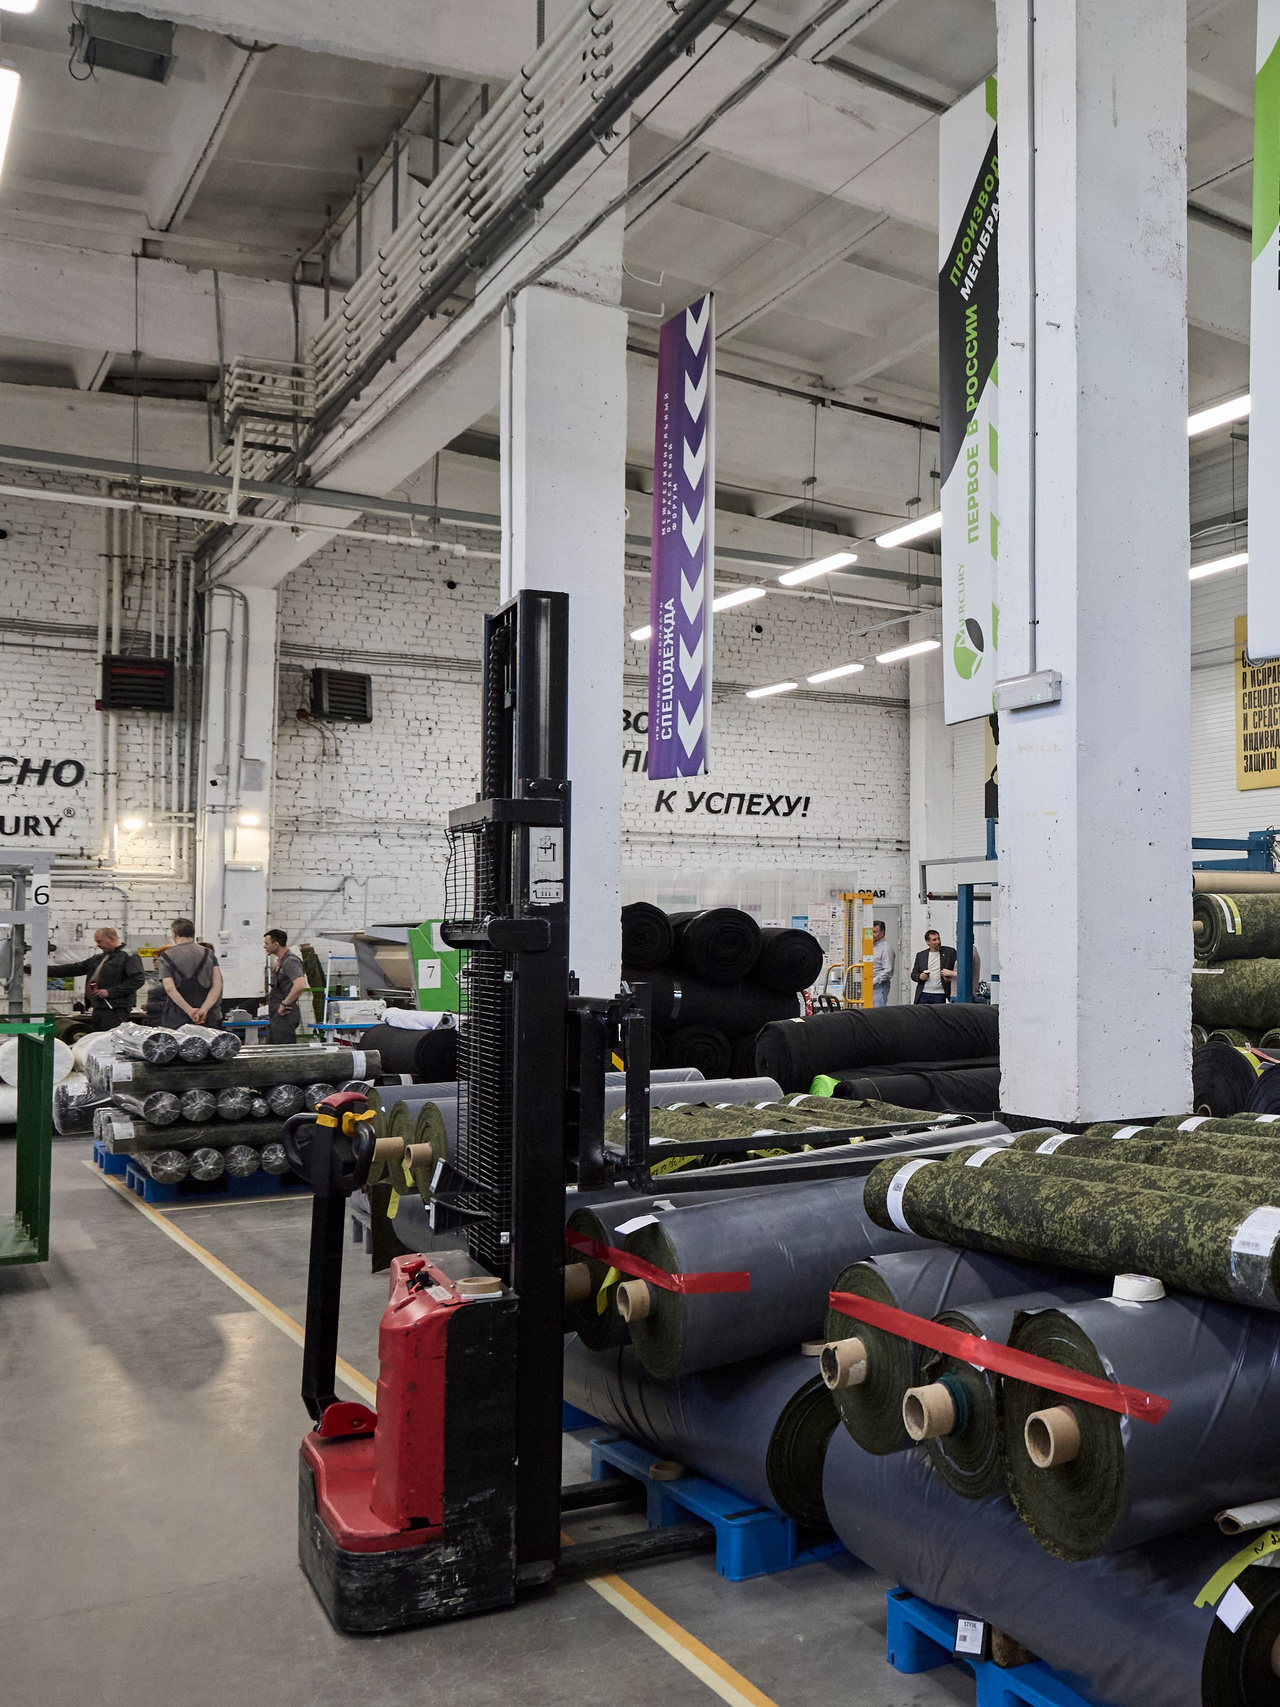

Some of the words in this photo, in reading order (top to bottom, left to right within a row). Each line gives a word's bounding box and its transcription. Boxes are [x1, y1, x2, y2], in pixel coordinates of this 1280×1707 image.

[959, 191, 999, 301] МЕМБРА
[965, 304, 978, 412] РОССИИ
[966, 419, 978, 437] В
[967, 444, 979, 544] ПЕРВОЕ
[955, 562, 966, 648] MERCURY
[662, 598, 675, 740] СПЕЦОДЕЖДА
[1242, 672, 1247, 690] В
[1243, 713, 1248, 731] И
[1243, 751, 1277, 773] ЗАЩИТЫ
[655, 790, 677, 813] К
[685, 791, 811, 818] УСПЕХУ!
[34, 885, 50, 905] 6
[427, 966, 435, 979] 7
